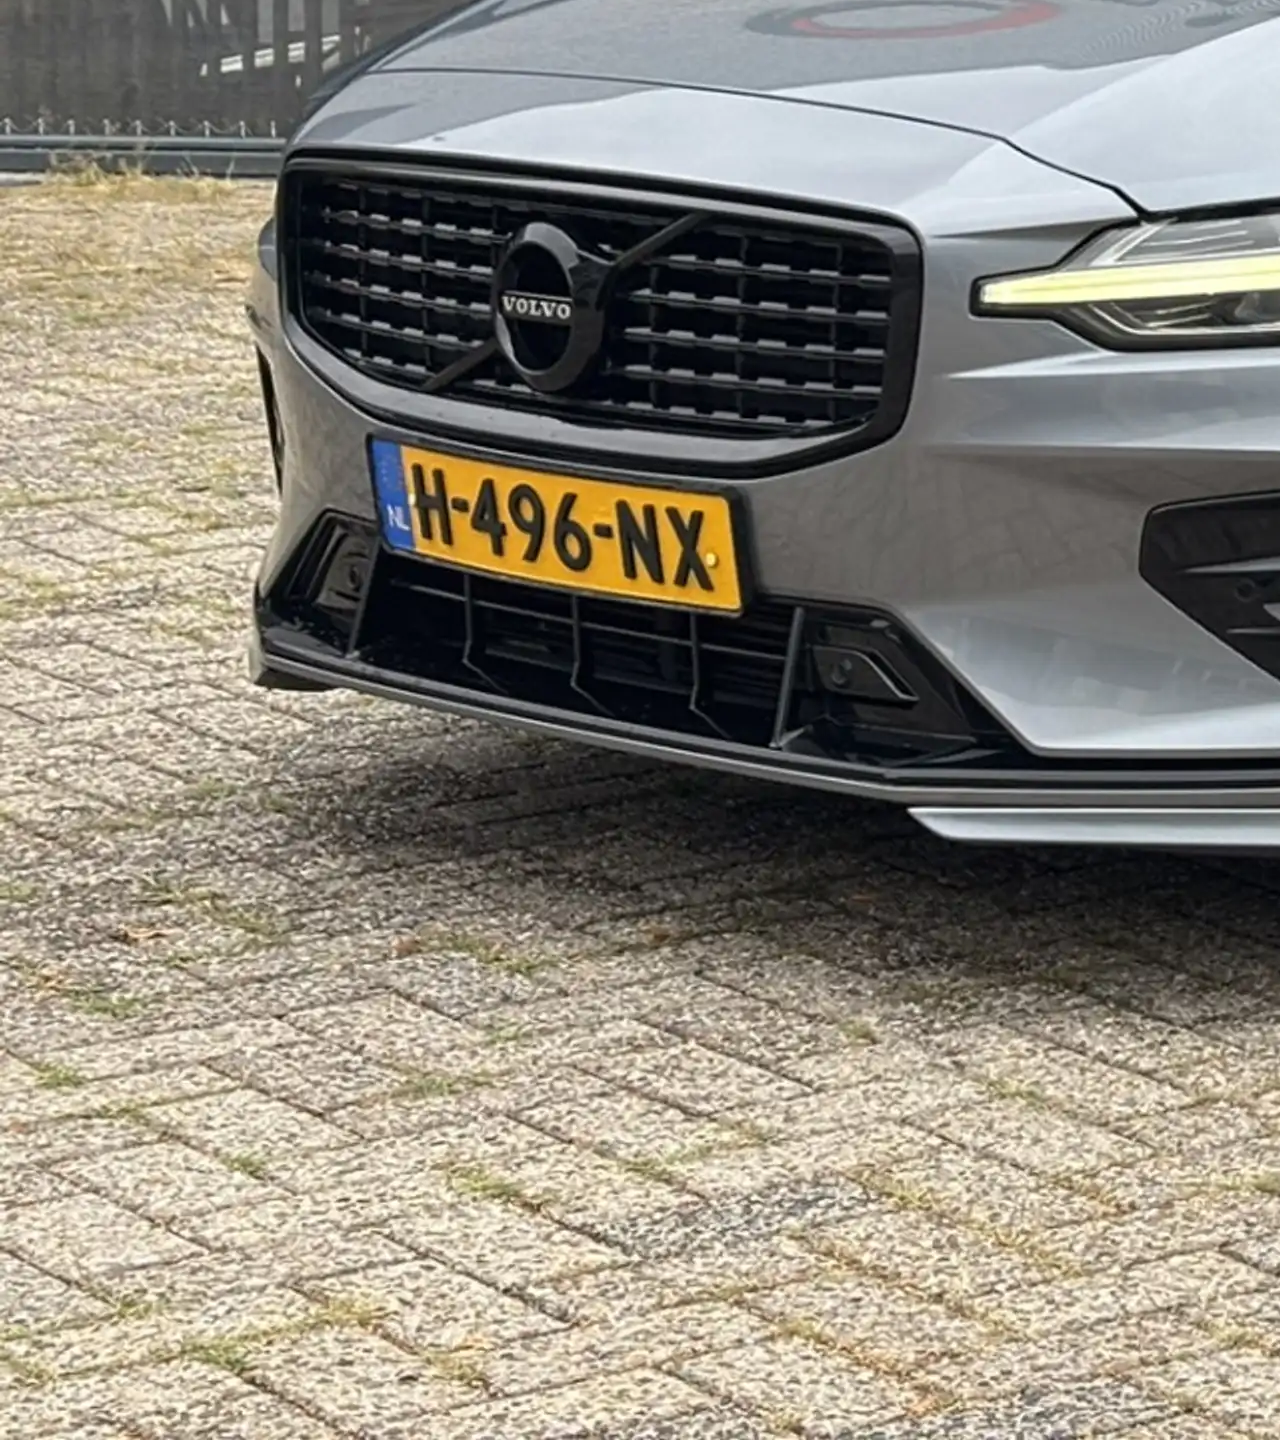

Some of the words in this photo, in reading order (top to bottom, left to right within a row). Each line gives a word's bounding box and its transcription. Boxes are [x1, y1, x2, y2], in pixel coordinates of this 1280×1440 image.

[502, 295, 572, 320] VOLVO
[386, 504, 411, 532] NL
[411, 463, 714, 592] H-496-NX
